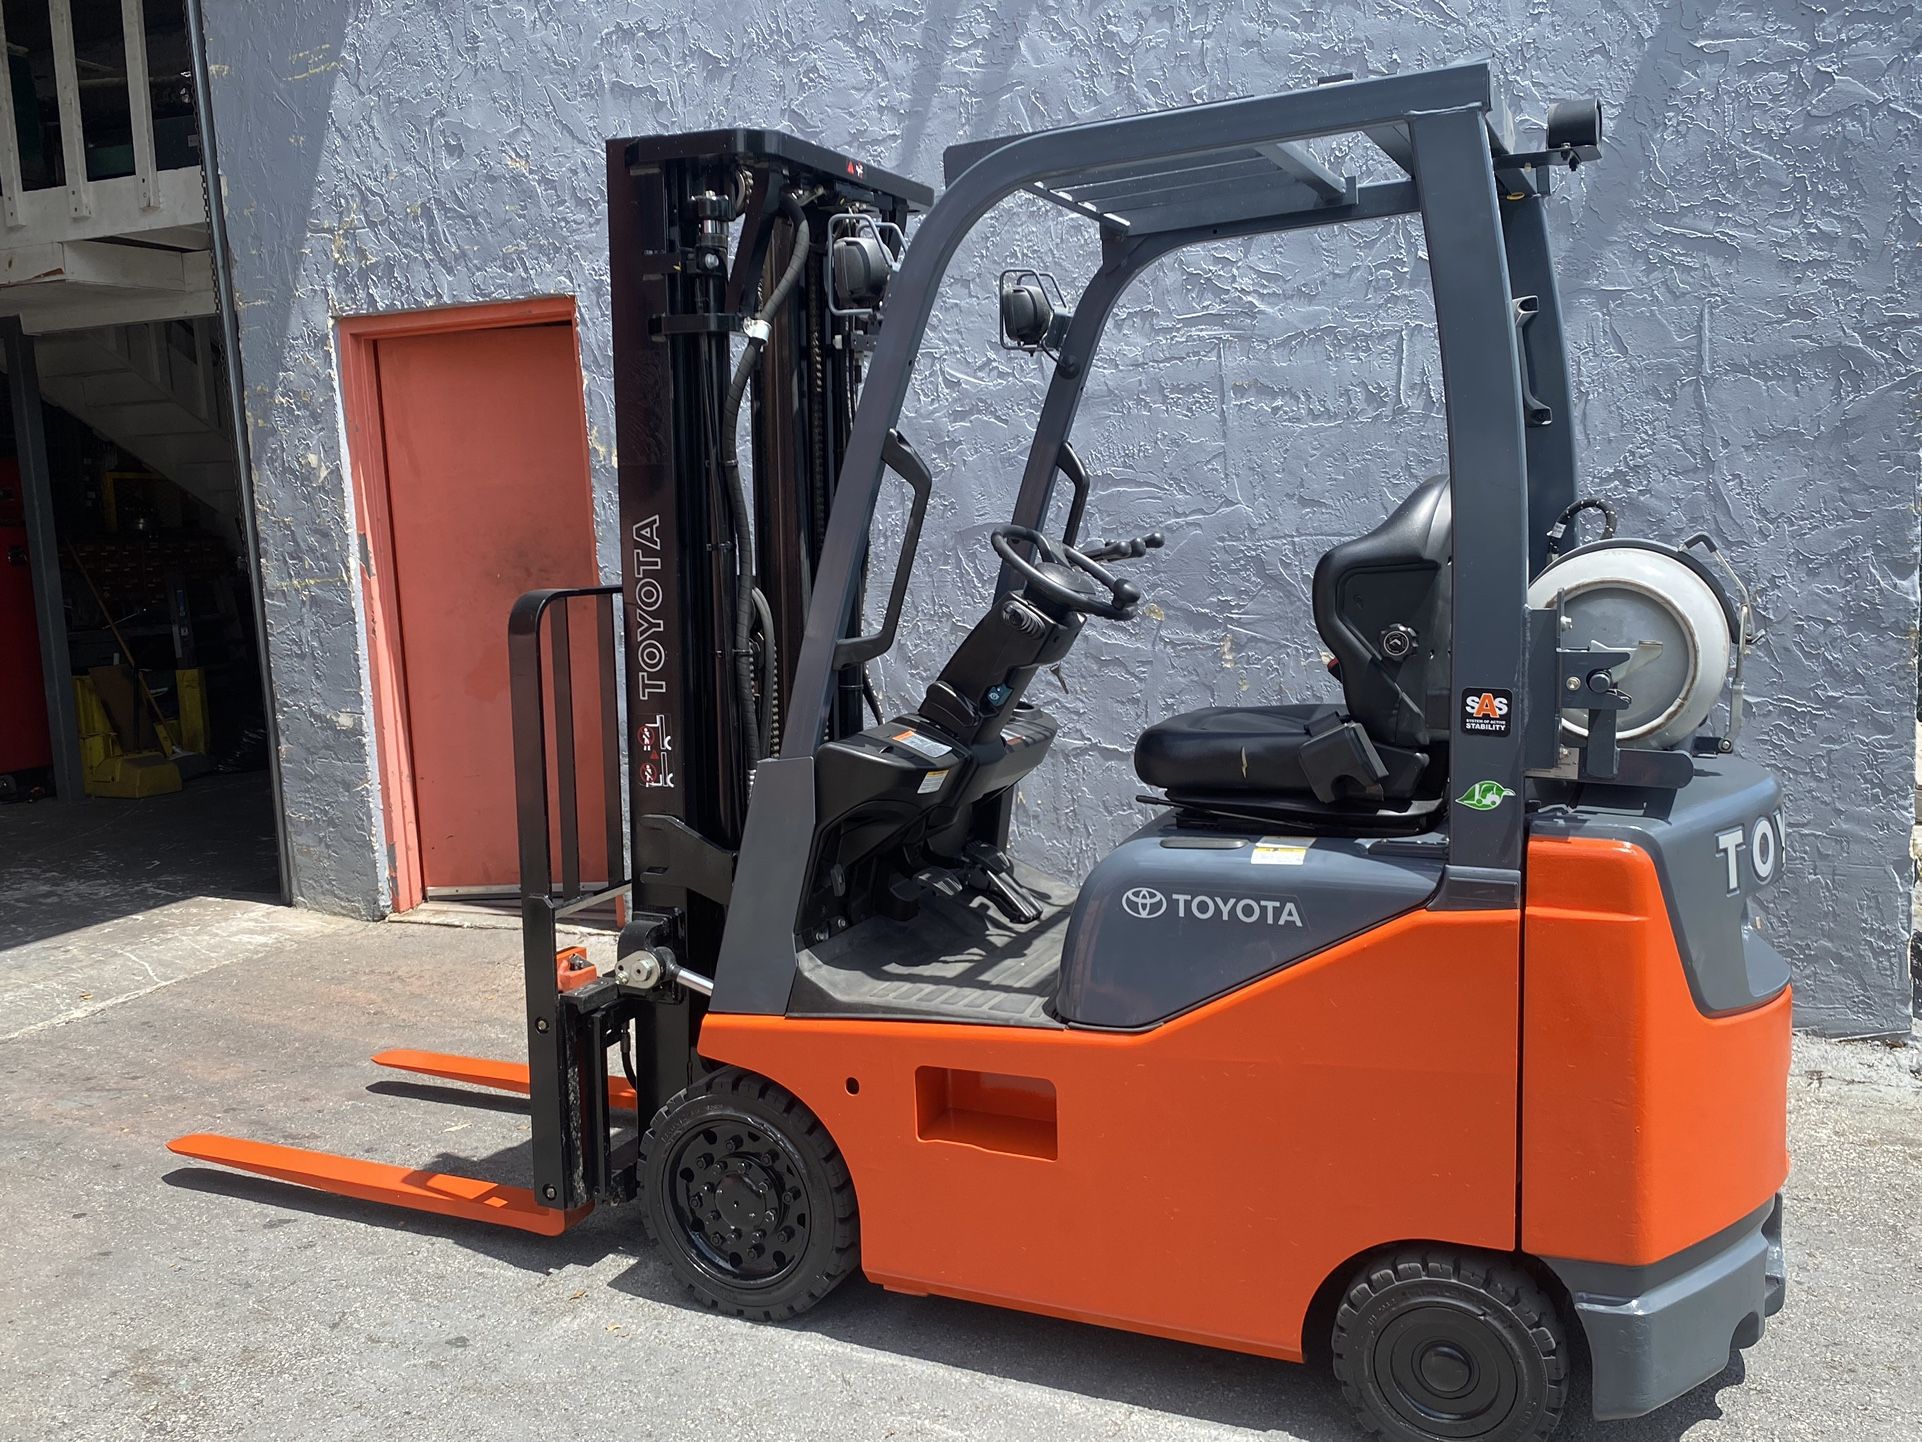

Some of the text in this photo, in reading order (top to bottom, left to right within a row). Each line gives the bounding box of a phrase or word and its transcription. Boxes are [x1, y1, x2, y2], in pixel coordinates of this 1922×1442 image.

[633, 514, 666, 700] TOYOTA
[1465, 693, 1509, 718] SAS
[1465, 722, 1506, 731] STABILITY
[1172, 894, 1303, 927] TOYOTA
